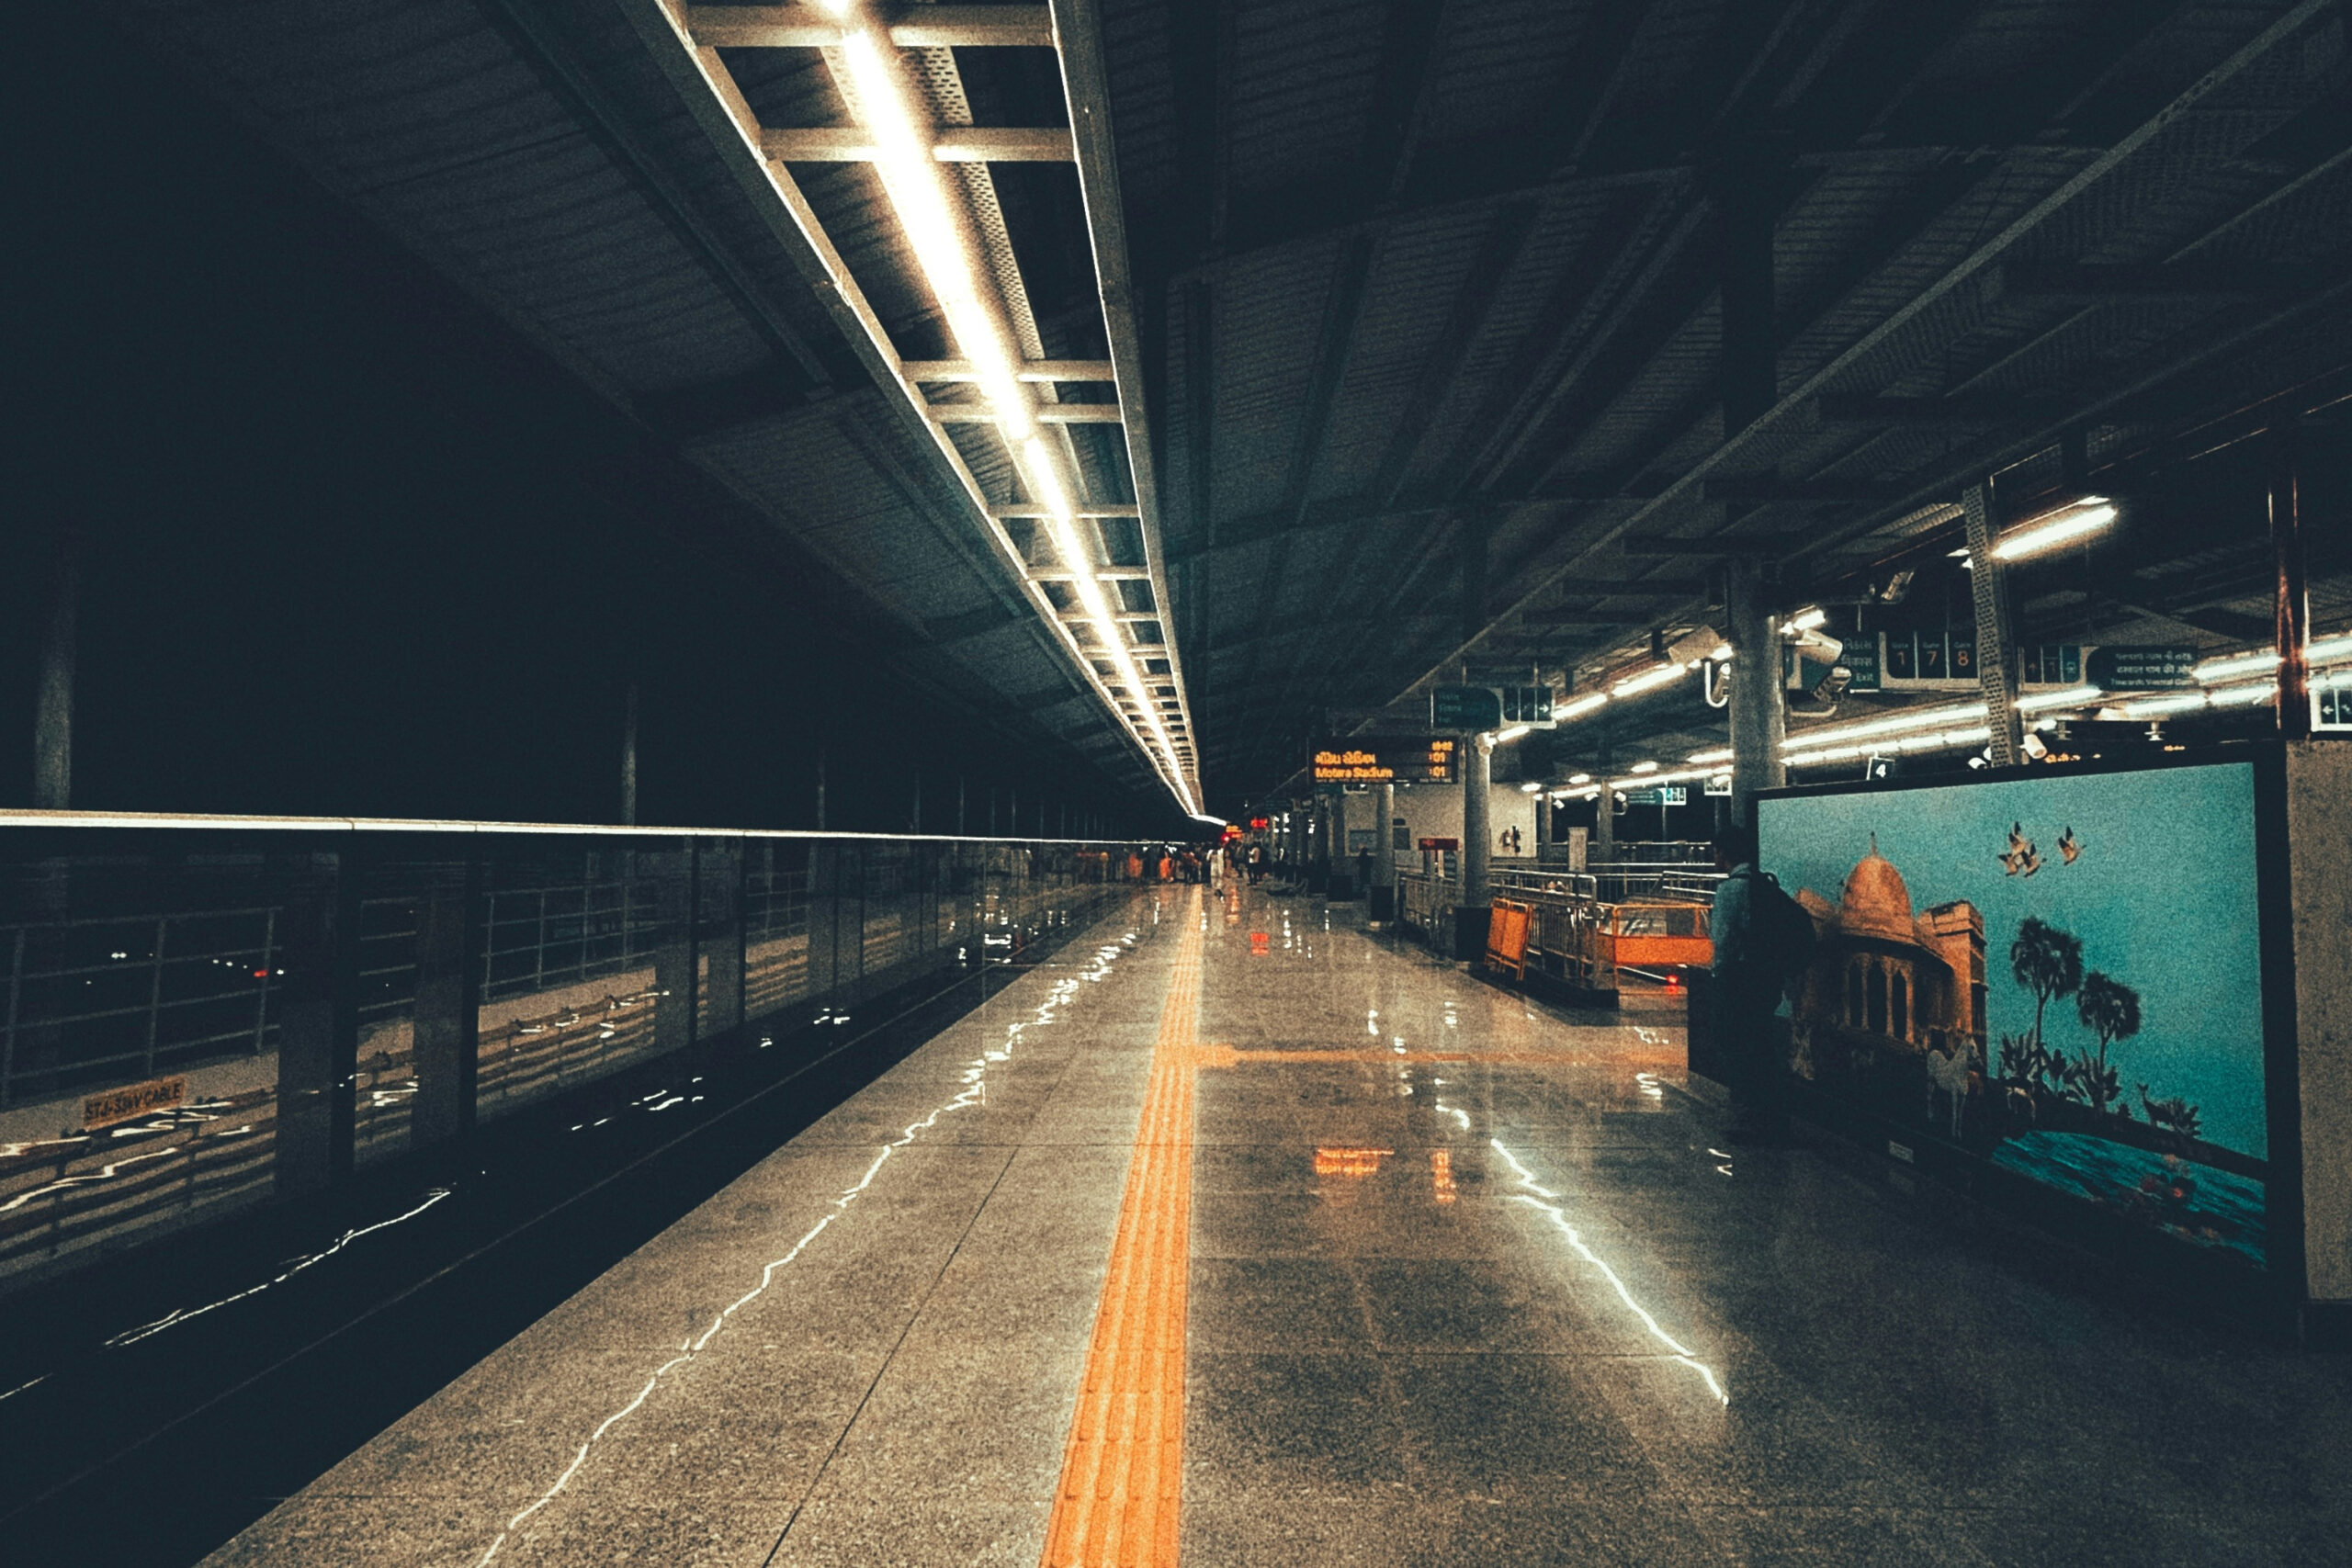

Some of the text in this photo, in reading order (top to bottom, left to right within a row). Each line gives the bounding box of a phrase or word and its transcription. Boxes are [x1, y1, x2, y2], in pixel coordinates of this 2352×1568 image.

[1897, 650, 1905, 666] 1
[1927, 650, 1938, 666] 7
[1958, 650, 1969, 667] 8
[1855, 671, 1874, 682] Exit
[1315, 766, 1394, 778] Motera Stadium
[1875, 763, 1886, 778] 4
[143, 1082, 181, 1107] CABLE
